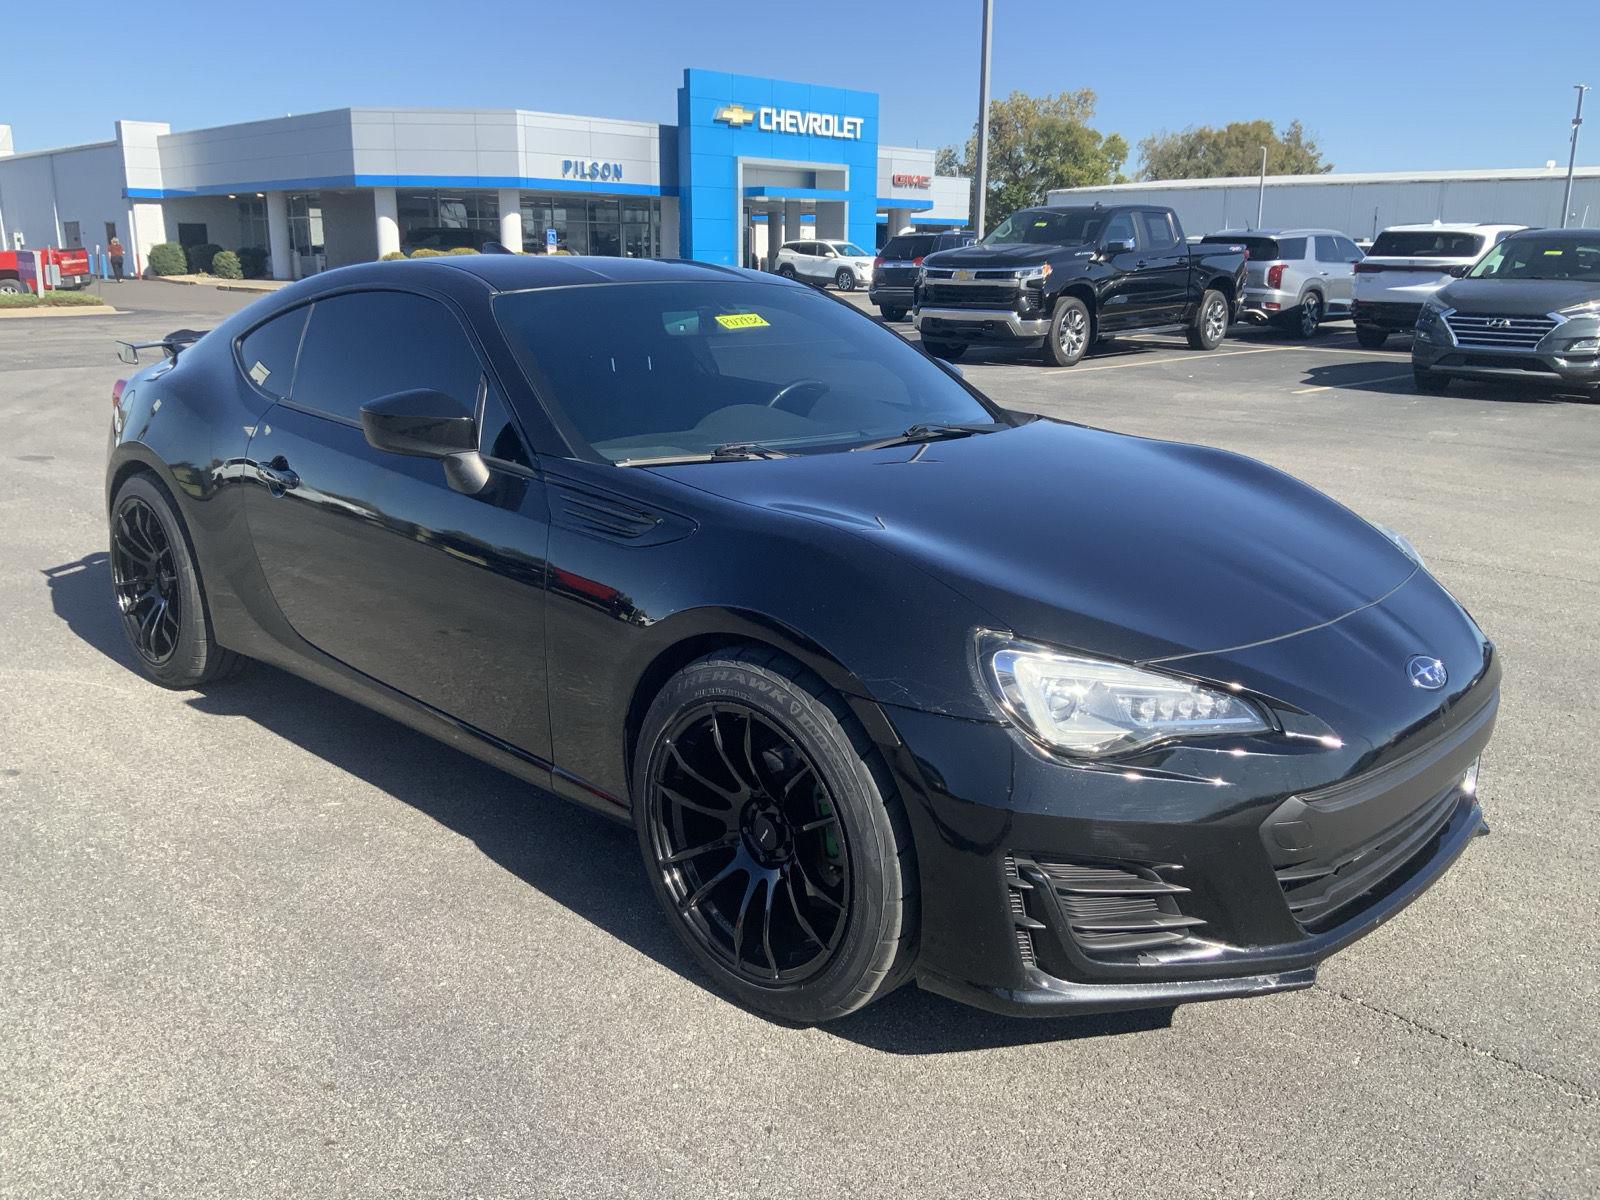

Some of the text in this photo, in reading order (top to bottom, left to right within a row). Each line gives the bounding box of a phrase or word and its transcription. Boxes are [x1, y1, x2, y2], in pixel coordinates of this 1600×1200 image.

[759, 107, 864, 139] CHEVROLET
[562, 160, 623, 181] PILSON
[893, 175, 932, 189] GMC
